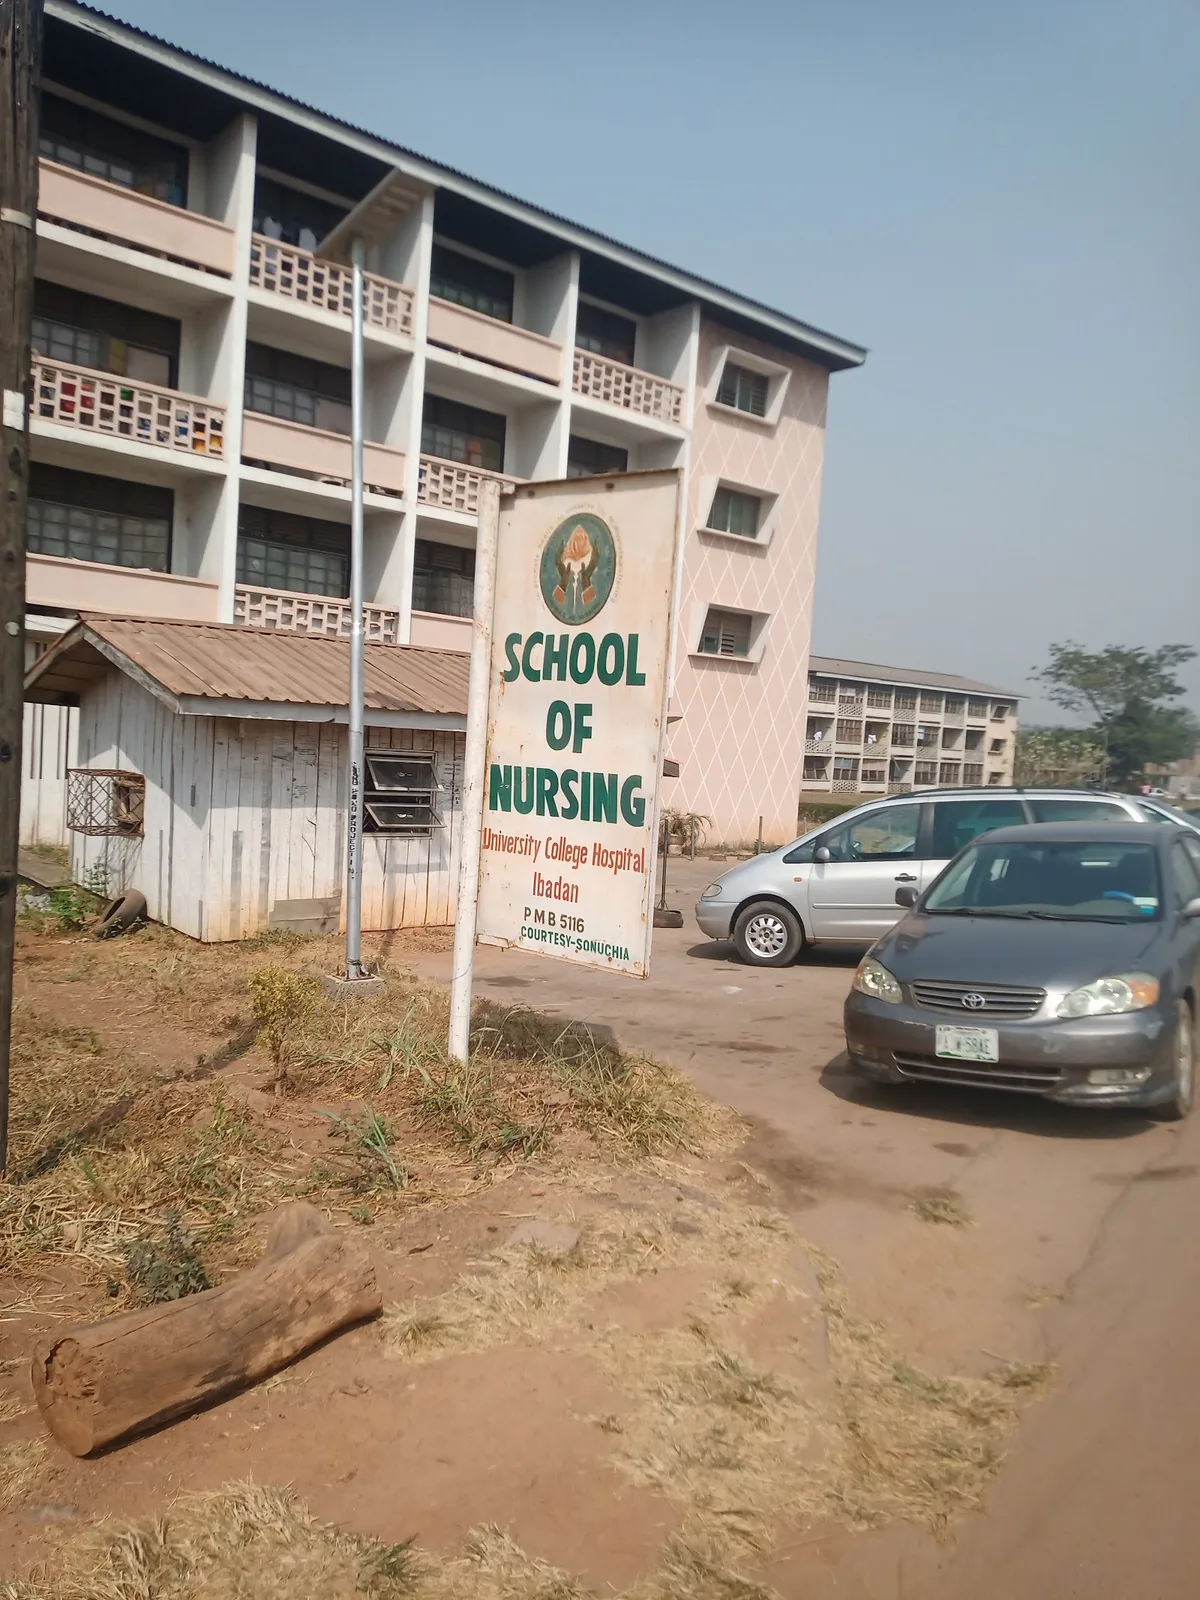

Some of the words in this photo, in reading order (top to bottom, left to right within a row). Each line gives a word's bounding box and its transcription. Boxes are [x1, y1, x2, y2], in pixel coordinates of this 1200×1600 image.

[504, 631, 646, 686] SCHOOL
[546, 700, 592, 753] OF
[489, 764, 646, 827] NURSING
[483, 827, 541, 863] University
[545, 837, 588, 869] College
[592, 843, 645, 875] Hospital
[532, 872, 579, 903] Ibadan
[524, 907, 532, 921] P
[534, 909, 546, 925] M
[549, 912, 556, 926] B
[560, 914, 585, 933] 5116
